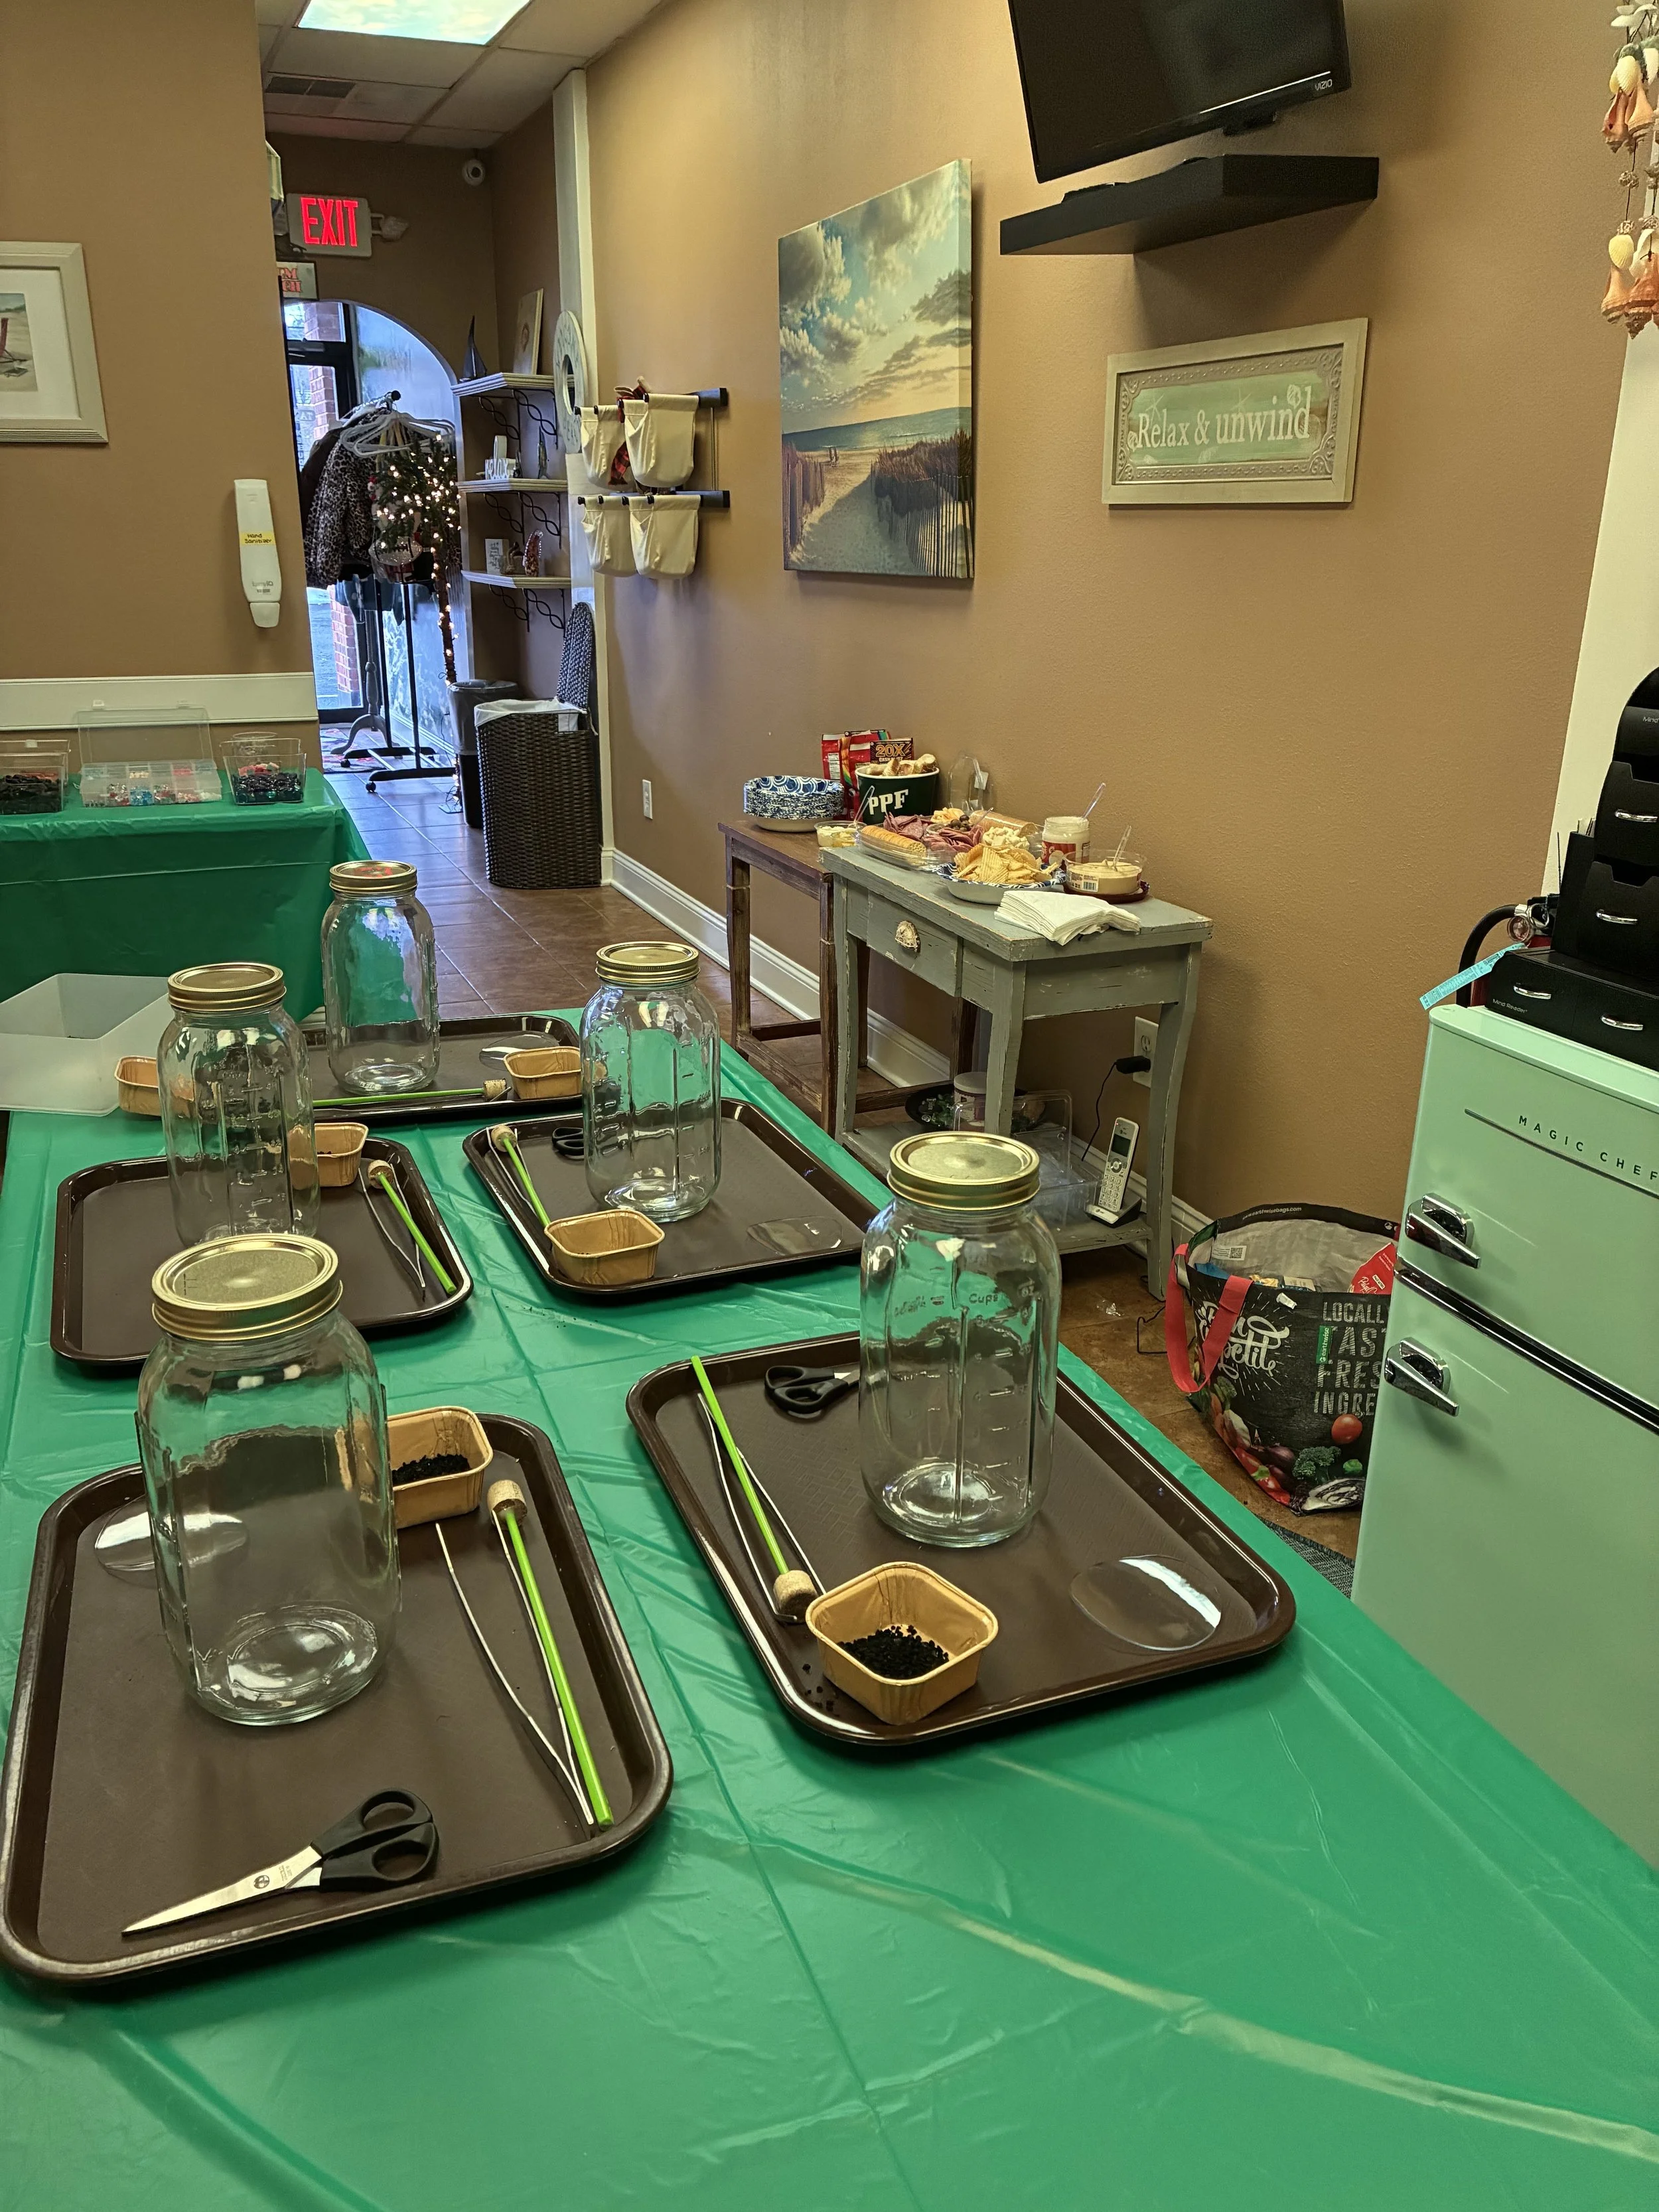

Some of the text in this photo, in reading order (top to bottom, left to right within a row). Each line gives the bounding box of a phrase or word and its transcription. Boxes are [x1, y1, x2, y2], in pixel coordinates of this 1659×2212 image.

[1315, 79, 1333, 91] VIZIO
[300, 196, 358, 248] EXIT
[1137, 386, 1312, 449] Relax & unwind
[485, 435, 510, 480] relax
[876, 743, 906, 757] 20X
[867, 789, 908, 815] PPF
[1506, 1003, 1525, 1013] Reader
[1519, 1116, 1658, 1180] MAGIC CHEF
